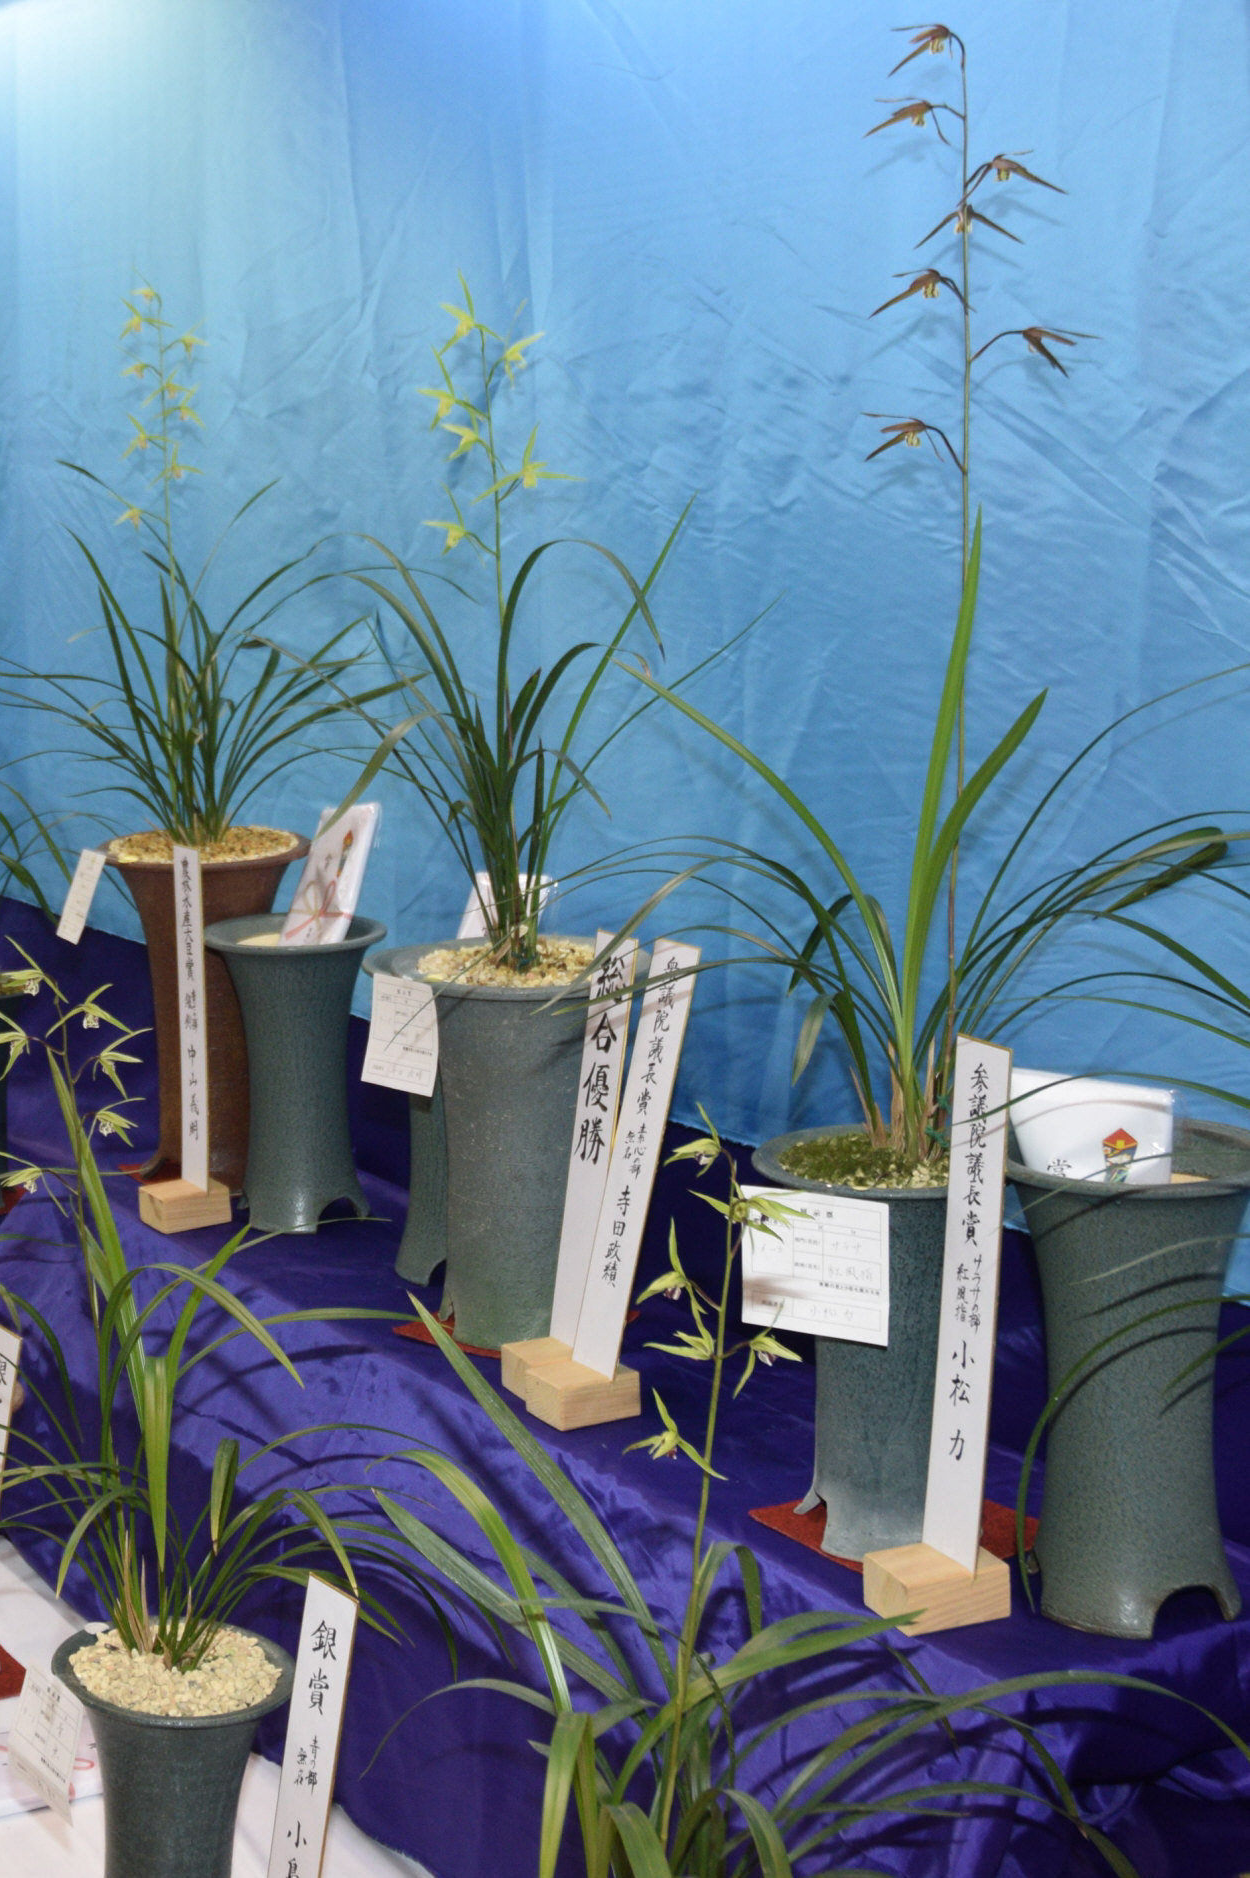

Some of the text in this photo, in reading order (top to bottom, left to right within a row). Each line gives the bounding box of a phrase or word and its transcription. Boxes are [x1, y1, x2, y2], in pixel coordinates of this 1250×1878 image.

[961, 1062, 990, 1246] 参議院議長賞
[309, 1619, 337, 1715] 銀賞
